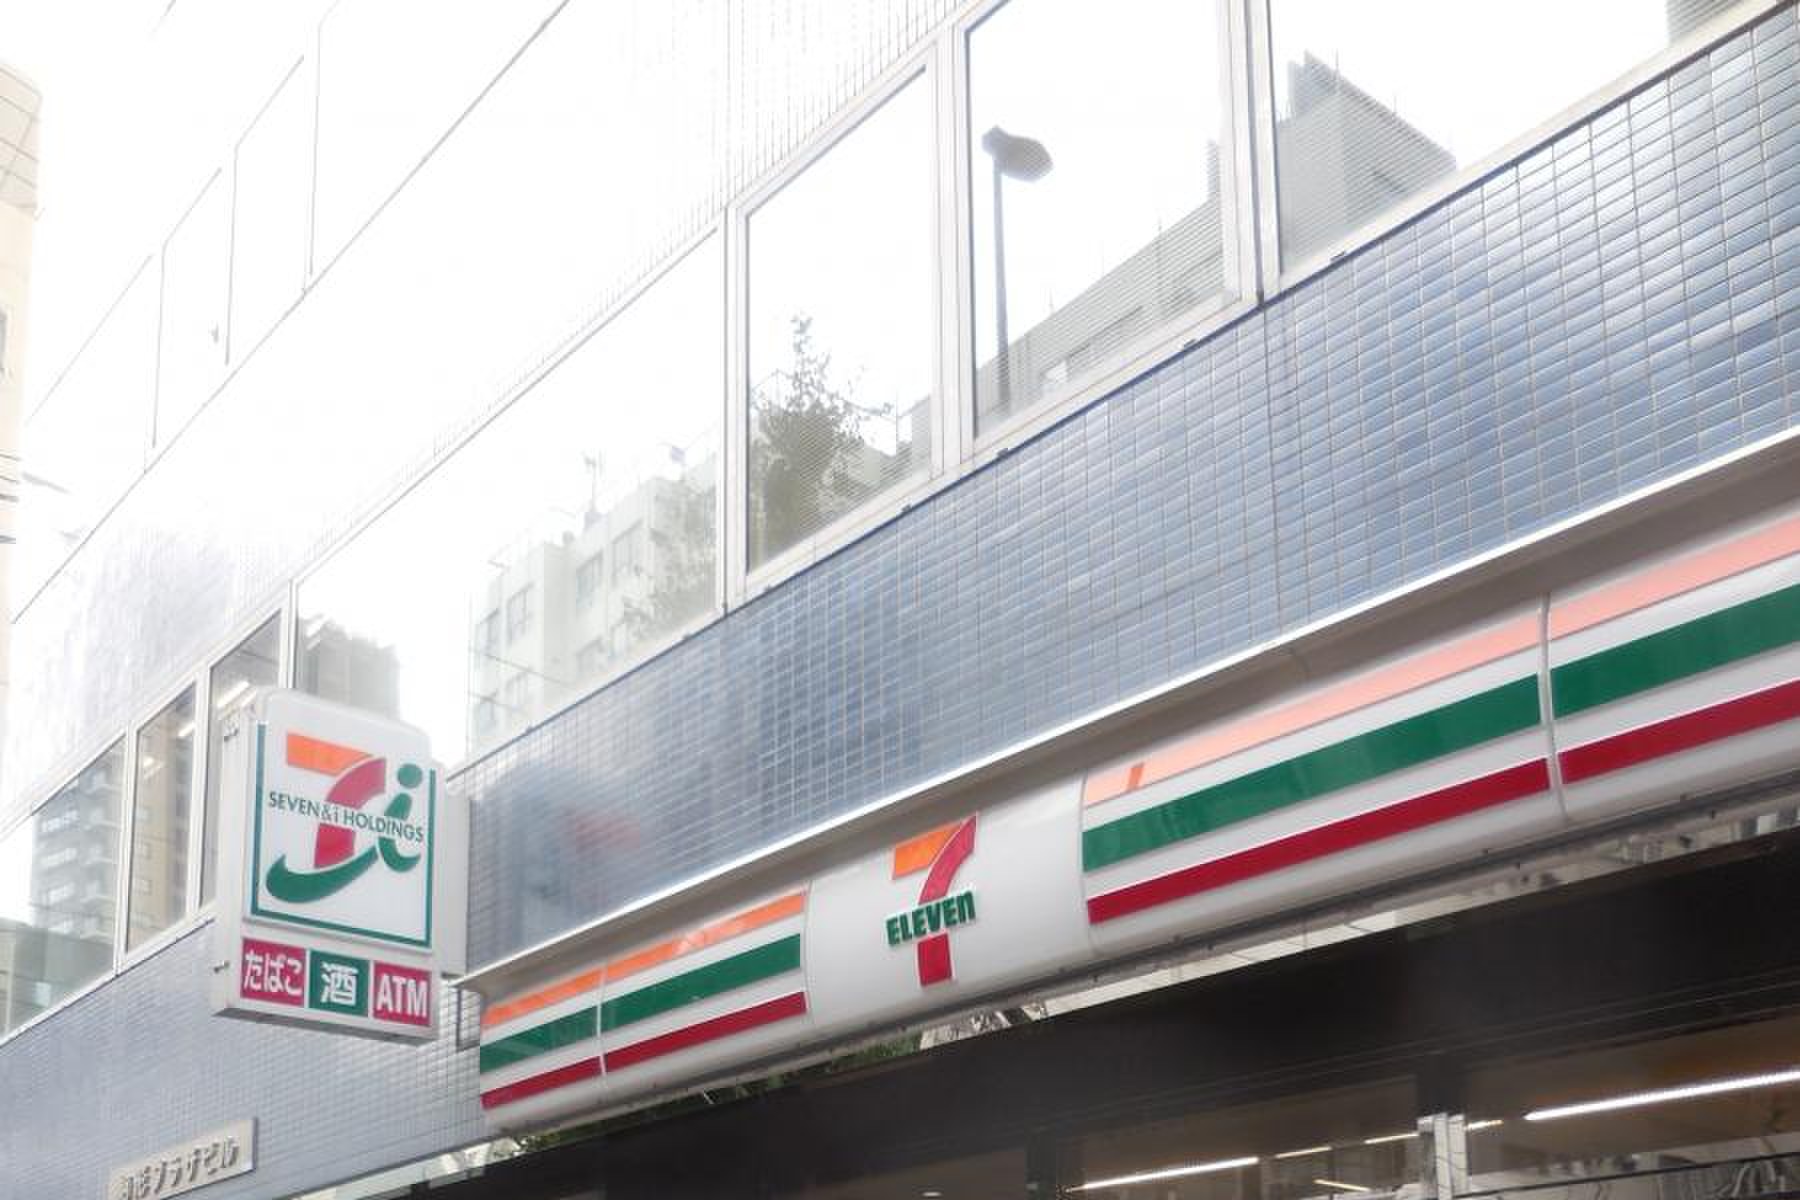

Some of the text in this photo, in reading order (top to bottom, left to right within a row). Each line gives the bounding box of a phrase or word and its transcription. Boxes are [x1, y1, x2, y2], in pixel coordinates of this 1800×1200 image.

[344, 811, 424, 843] HOLDINGS
[320, 961, 359, 1006] 酒
[376, 974, 428, 1019] ATM
